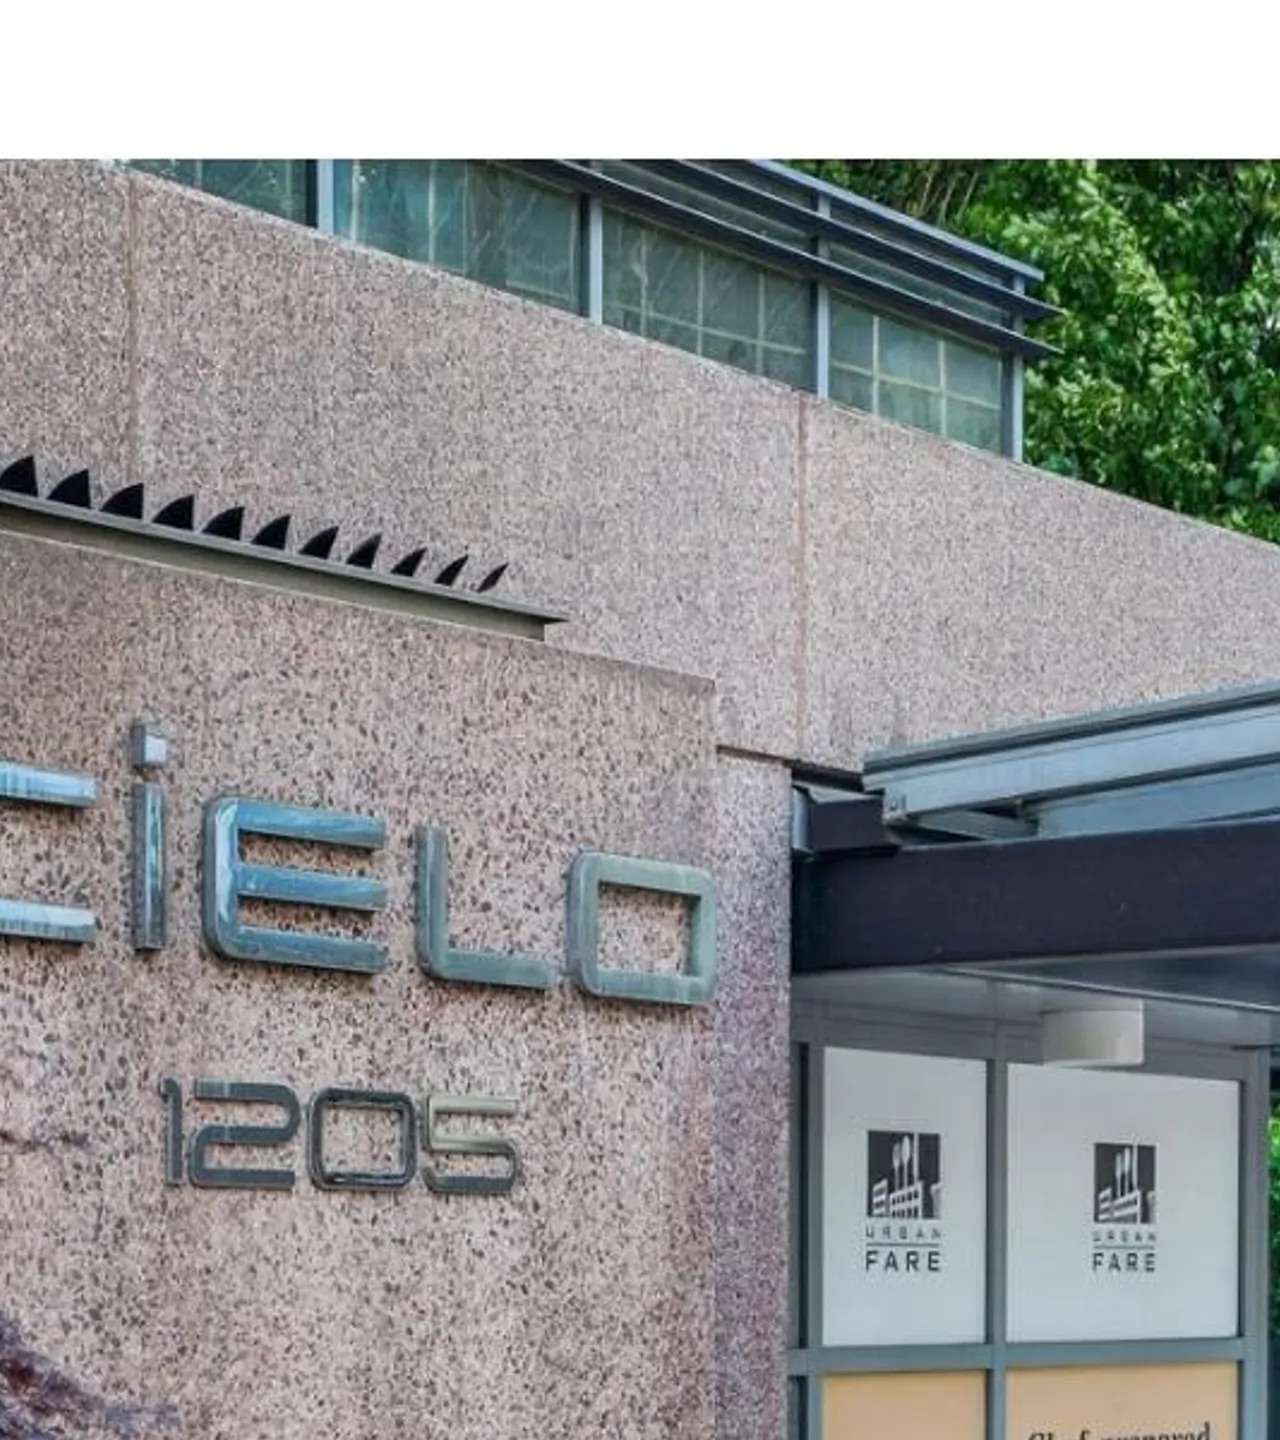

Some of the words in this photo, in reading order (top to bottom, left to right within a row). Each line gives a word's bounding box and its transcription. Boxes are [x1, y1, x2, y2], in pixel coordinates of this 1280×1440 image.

[156, 1076, 518, 1195] 1205
[865, 1250, 941, 1273] FARE
[1092, 1252, 1156, 1273] FARE
